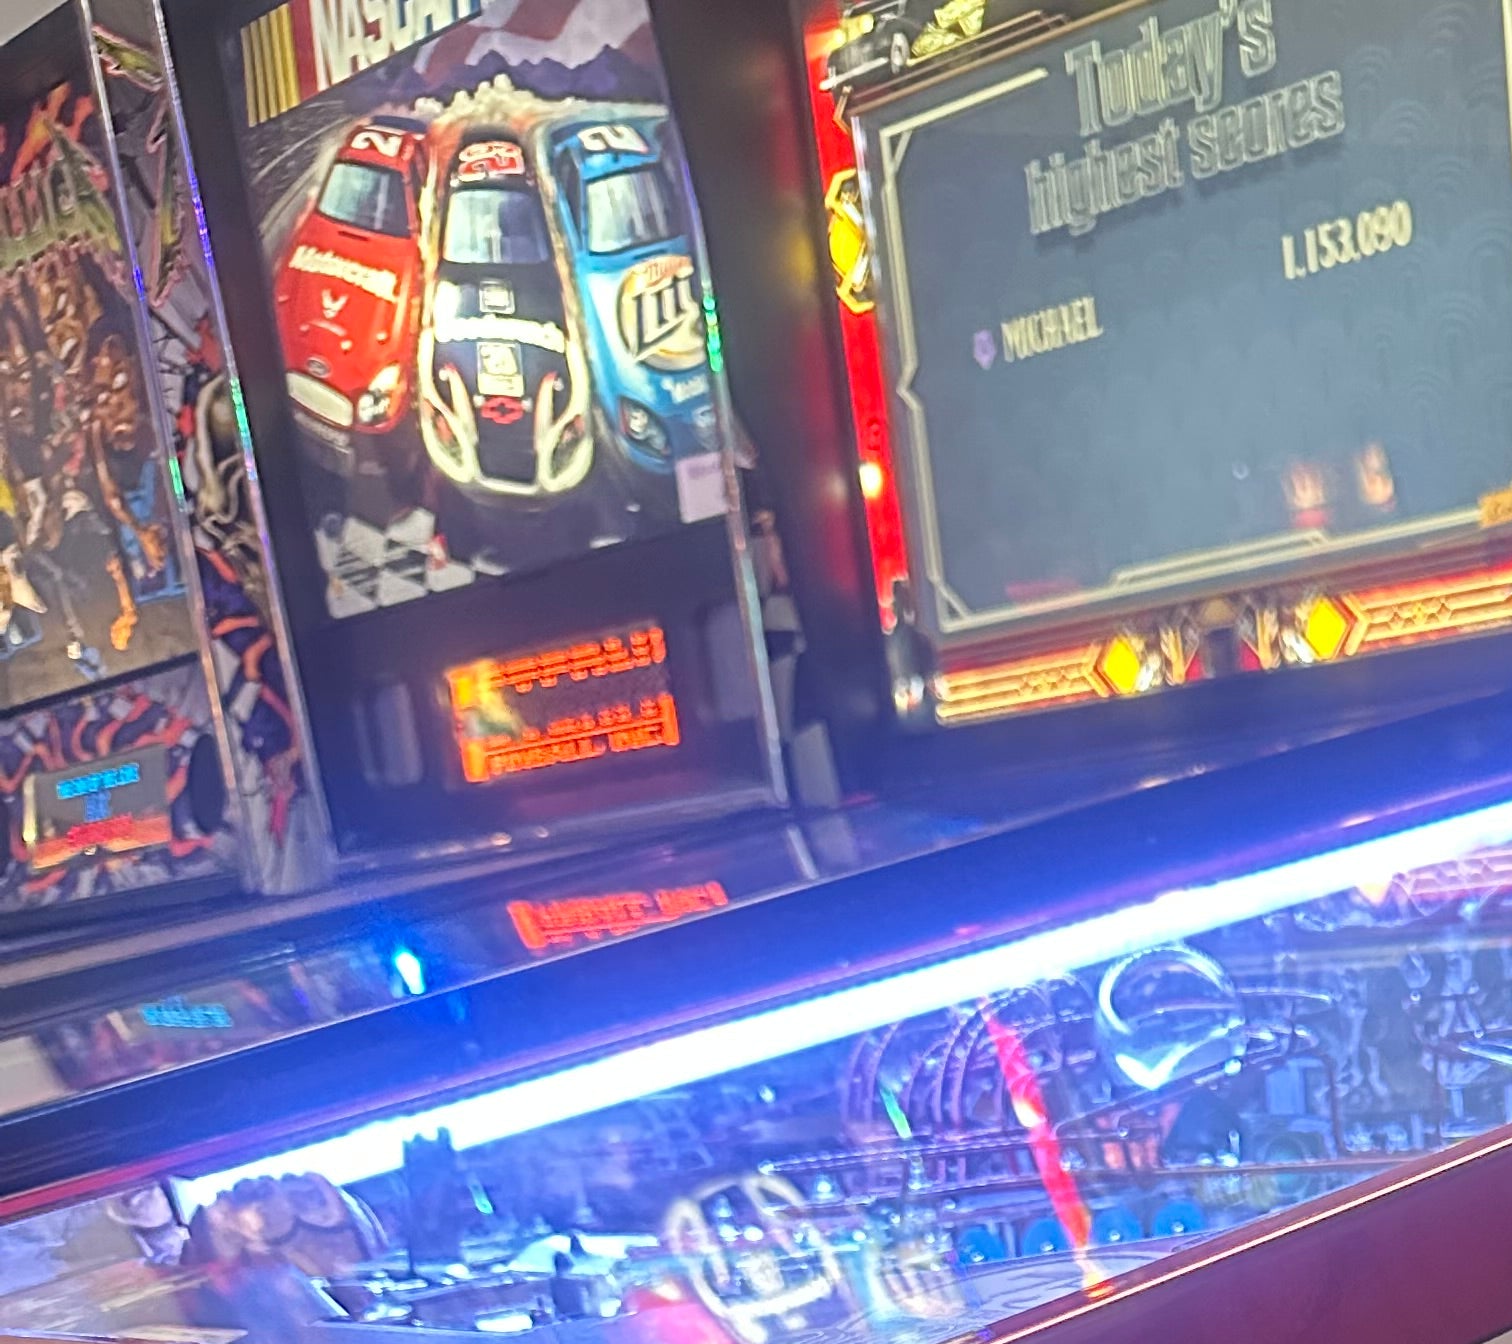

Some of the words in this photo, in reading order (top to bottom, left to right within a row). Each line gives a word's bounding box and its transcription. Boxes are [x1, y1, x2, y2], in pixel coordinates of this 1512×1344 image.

[1065, 0, 1277, 137] Today's
[1024, 117, 1185, 237] highest
[1187, 69, 1346, 180] scores
[1000, 296, 1104, 363] MICHAEL
